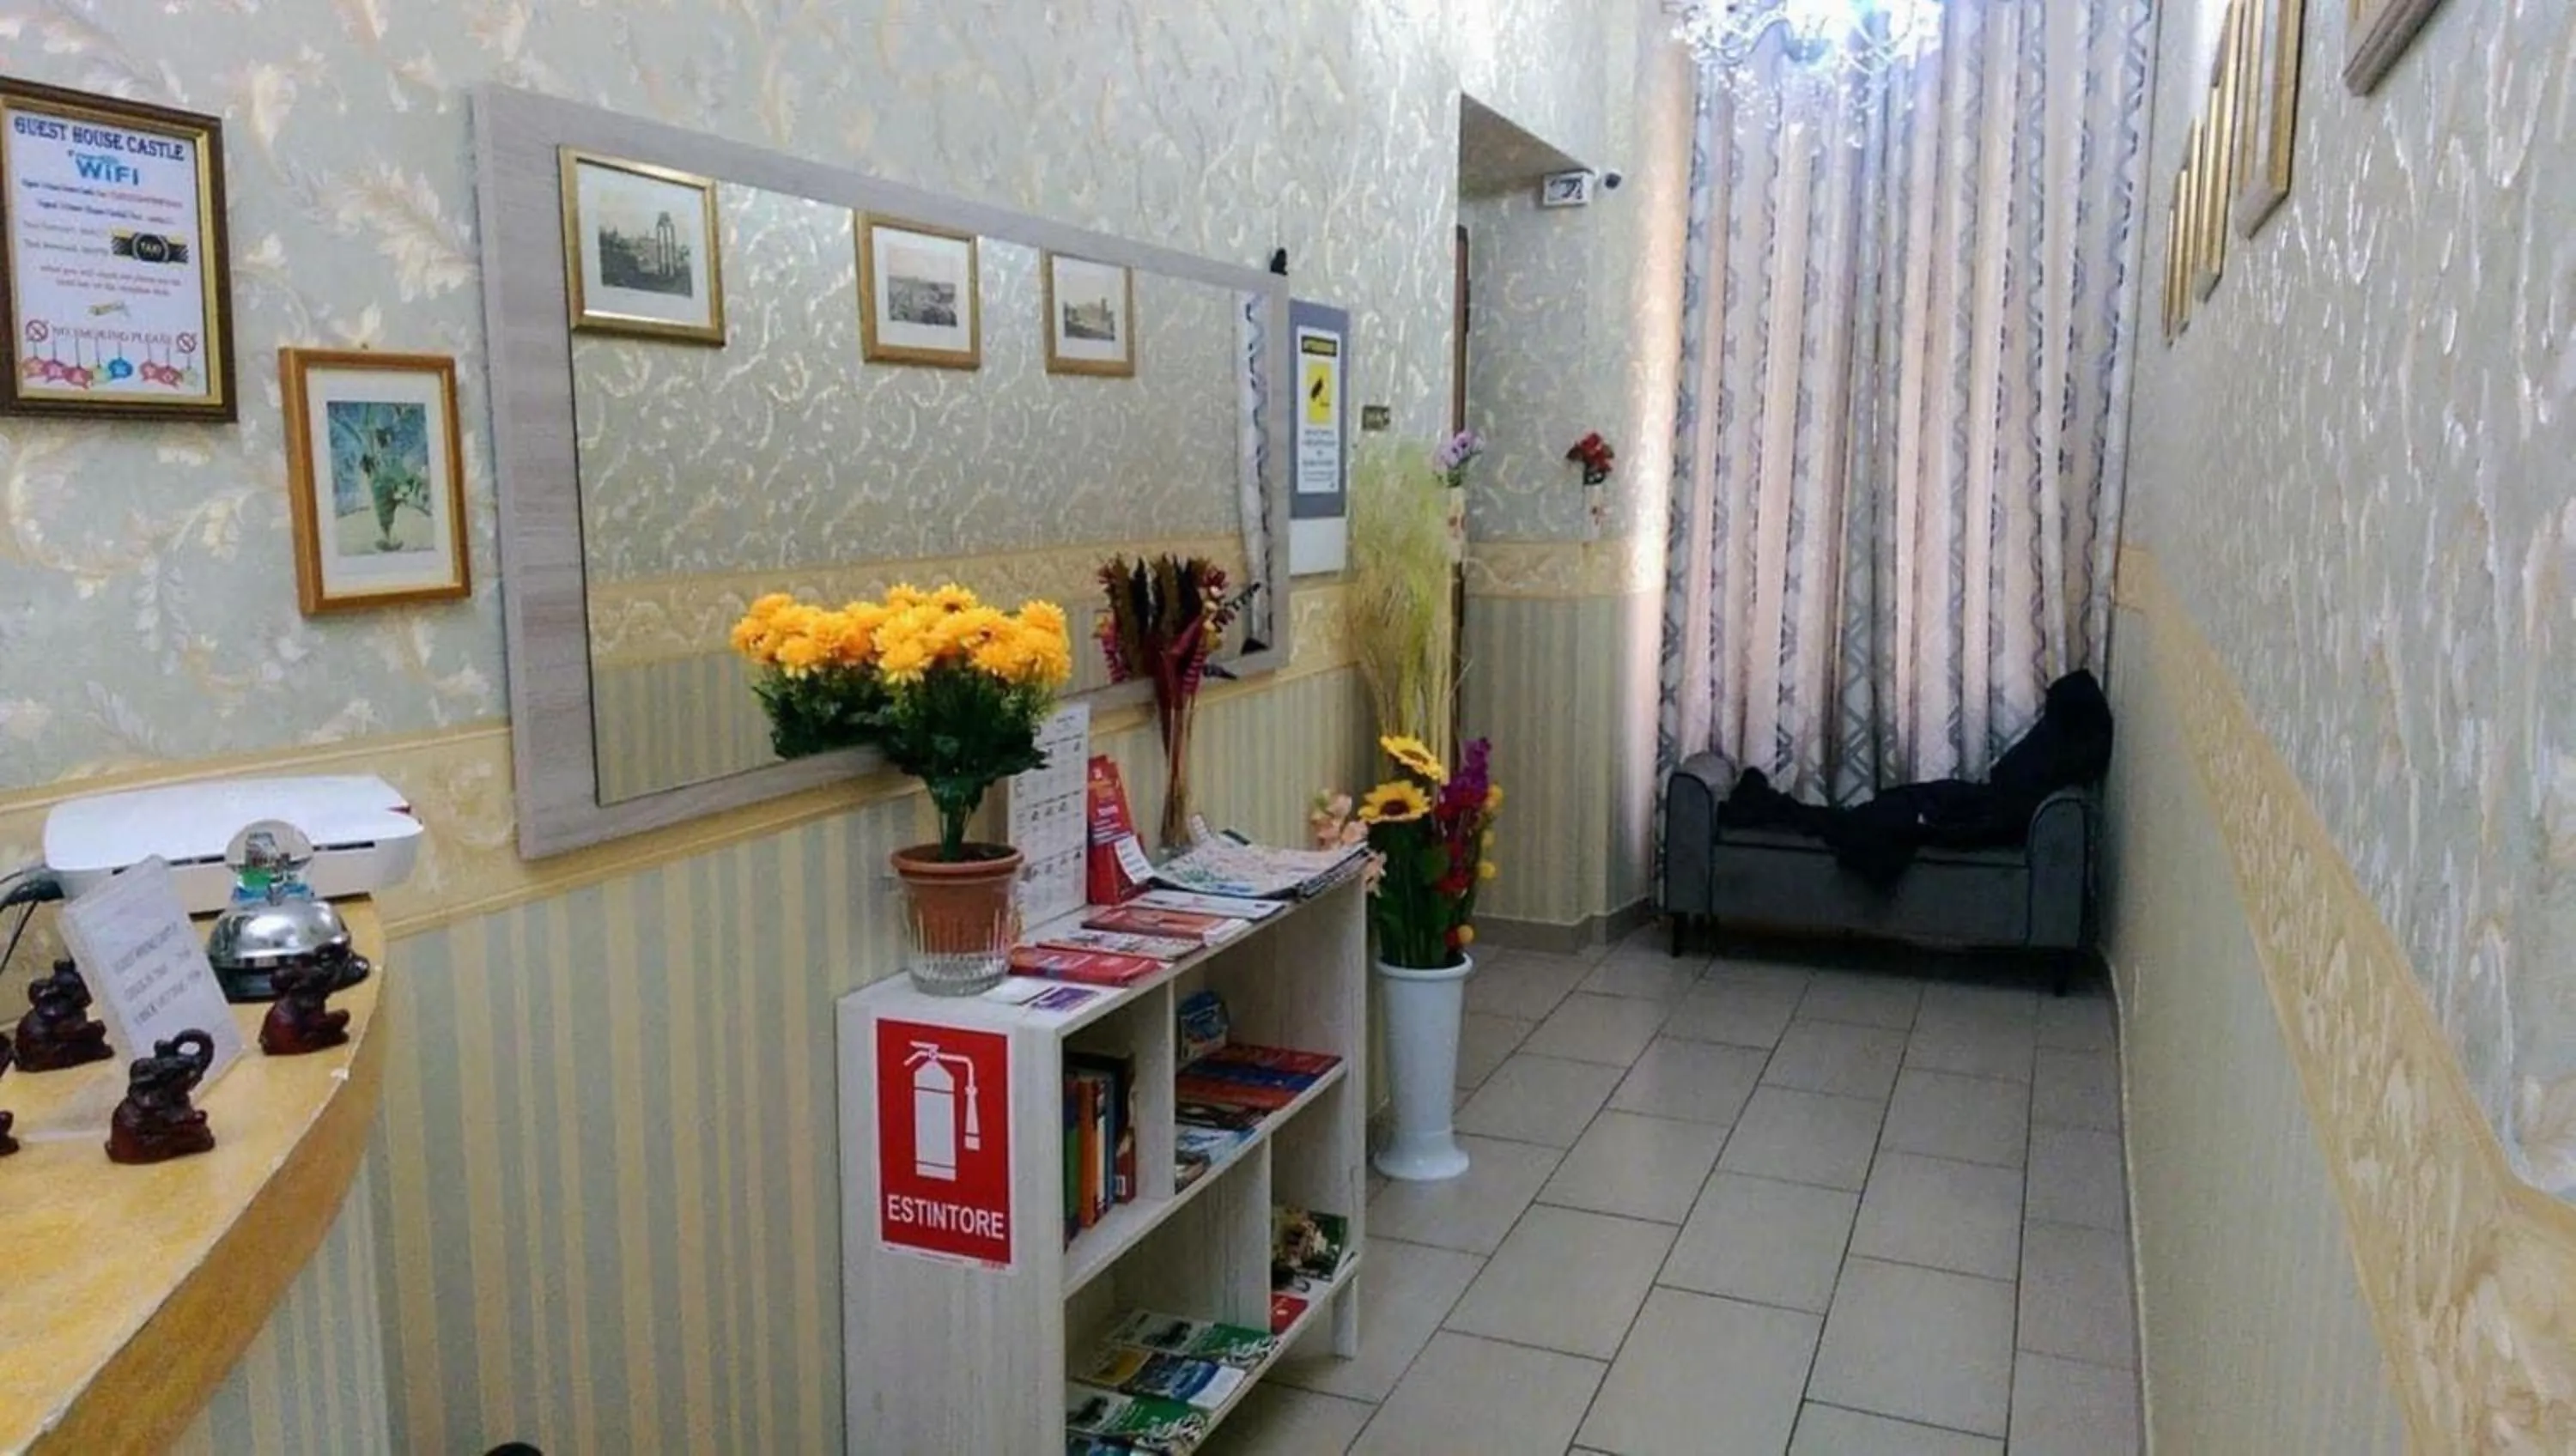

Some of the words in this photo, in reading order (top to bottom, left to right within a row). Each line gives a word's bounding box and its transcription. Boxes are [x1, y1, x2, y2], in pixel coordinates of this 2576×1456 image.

[14, 116, 68, 141] GUEST
[73, 126, 124, 150] HOUSE
[126, 136, 185, 161] CASTLE
[887, 1194, 1005, 1240] ESTINTORE
